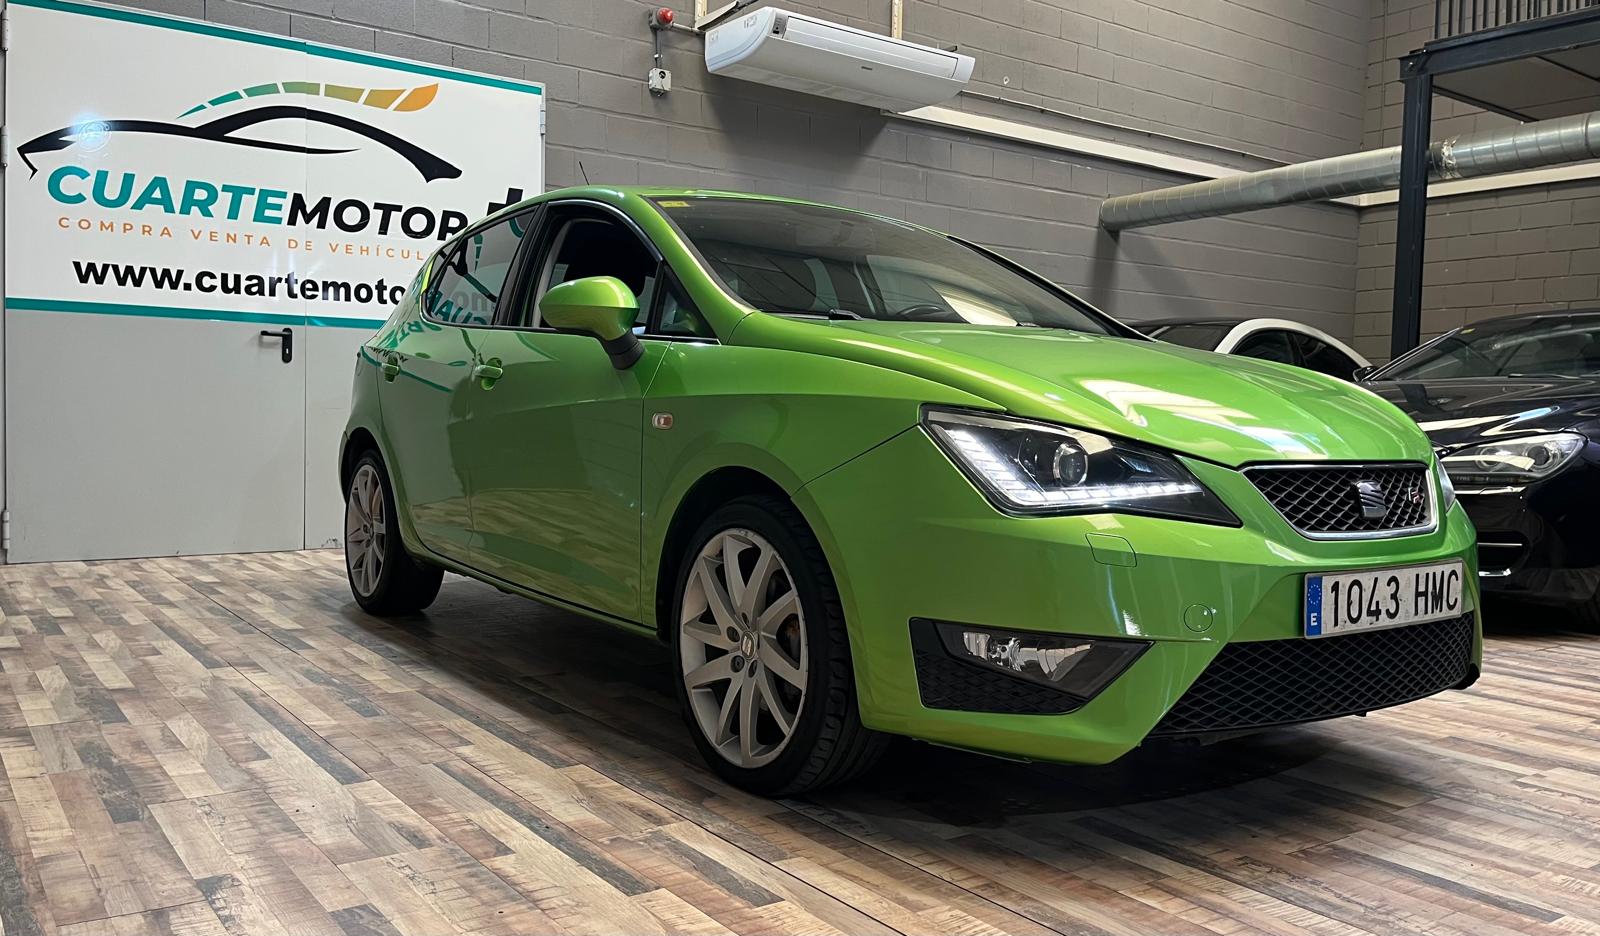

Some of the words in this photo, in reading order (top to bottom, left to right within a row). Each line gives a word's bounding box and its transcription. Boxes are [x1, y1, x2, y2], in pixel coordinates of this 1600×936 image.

[47, 165, 469, 241] CUARTEMOTOR
[58, 216, 173, 238] COMPRA
[190, 228, 271, 247] VENTA
[287, 238, 313, 251] DE
[329, 242, 433, 261] VEHÍCUL
[1310, 612, 1318, 626] E
[1330, 575, 1400, 628] 1043
[1414, 569, 1459, 617] HMC
